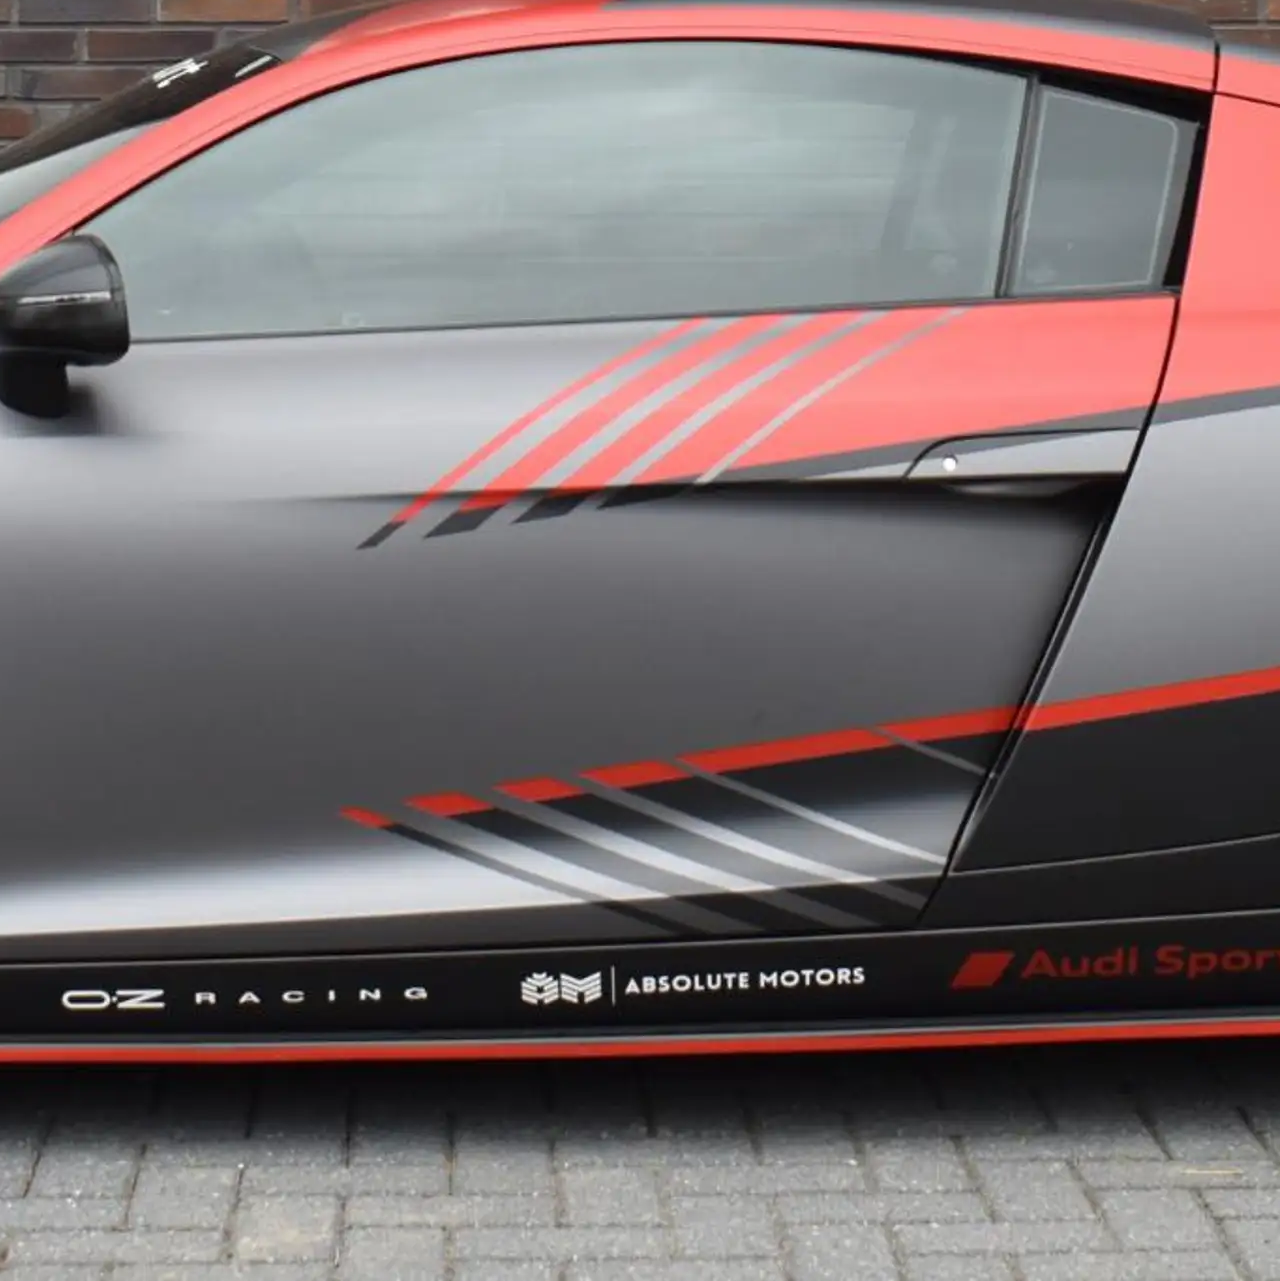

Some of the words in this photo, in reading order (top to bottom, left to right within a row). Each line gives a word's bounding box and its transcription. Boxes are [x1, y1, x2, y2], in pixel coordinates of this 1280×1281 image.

[1022, 948, 1138, 978] Audi
[194, 985, 429, 1005] RACING
[624, 971, 751, 995] ABSOLUTE
[759, 966, 866, 989] MOTORS
